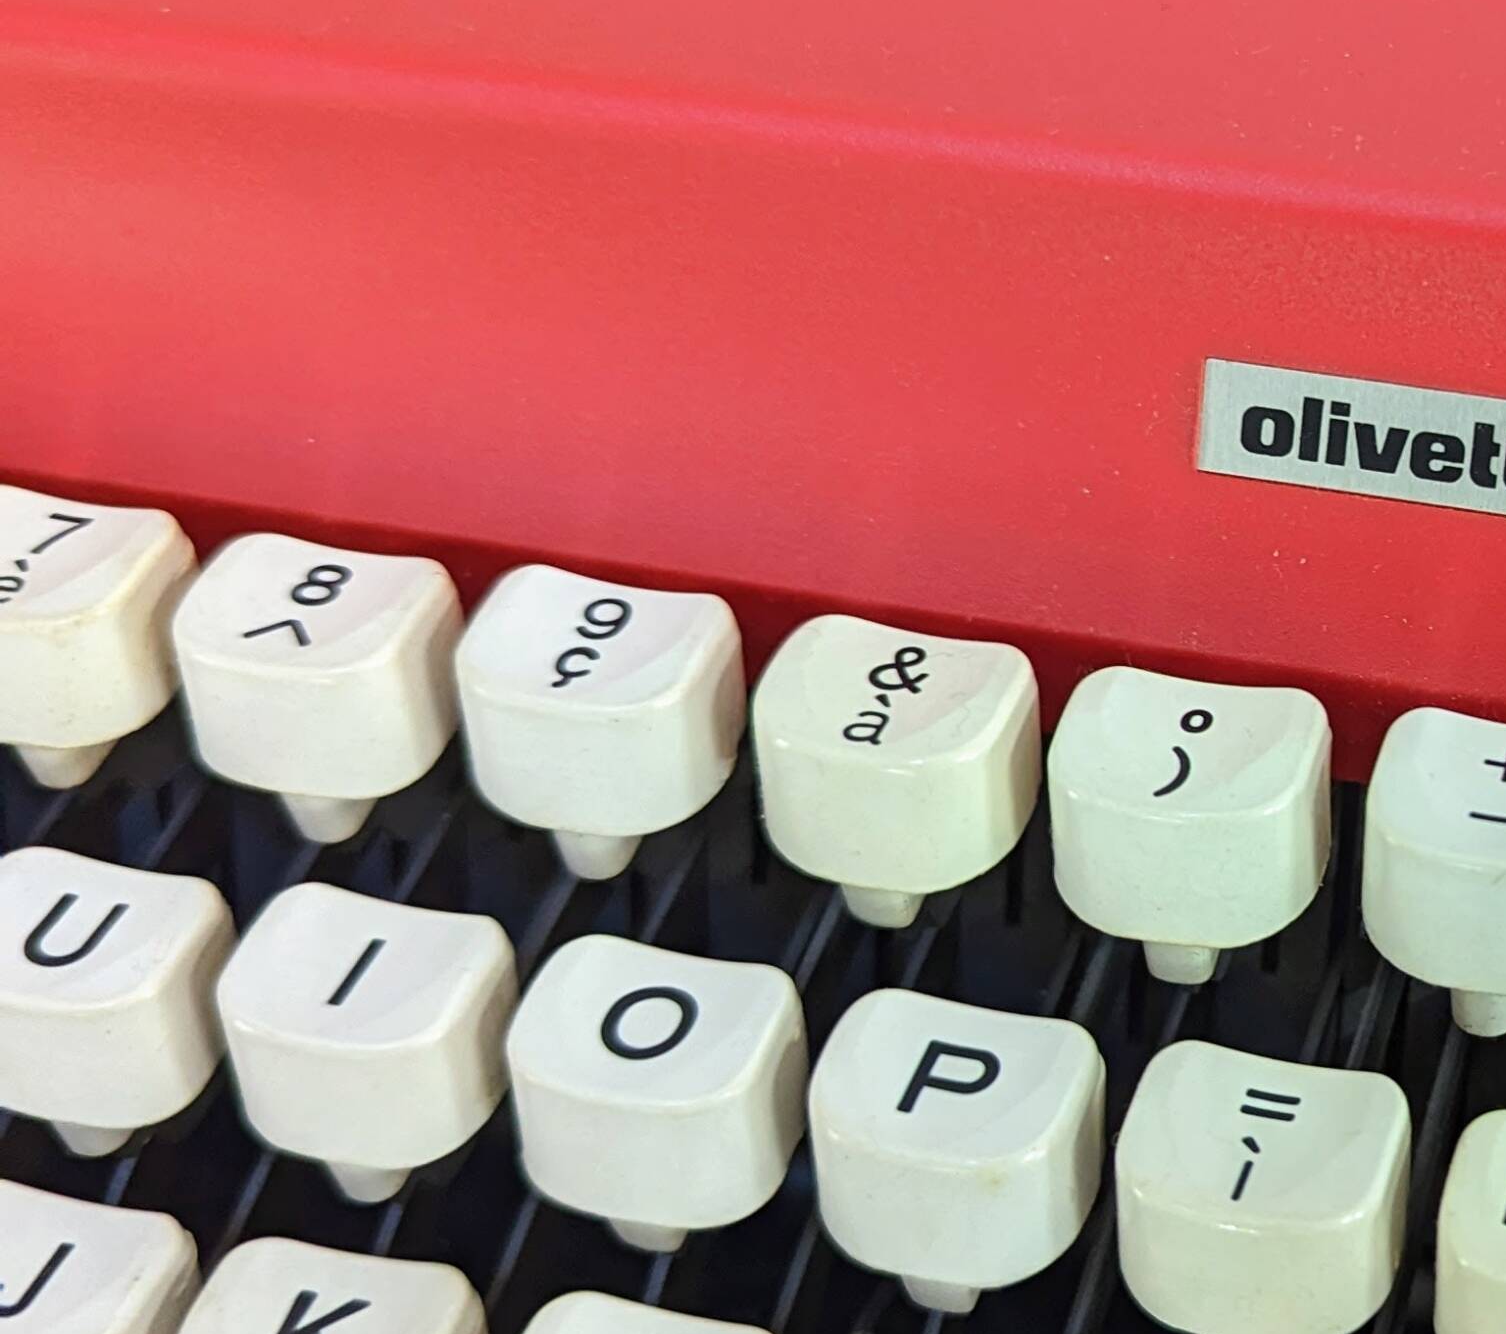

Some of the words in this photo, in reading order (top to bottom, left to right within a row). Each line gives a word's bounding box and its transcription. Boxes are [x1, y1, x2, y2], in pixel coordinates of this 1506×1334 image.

[30, 512, 95, 554] 7
[289, 564, 352, 607] 8
[575, 598, 632, 640] 9
[551, 646, 601, 689] ç
[868, 646, 929, 695] &
[842, 693, 891, 746] à
[23, 893, 129, 968] U
[326, 938, 386, 1006] I
[599, 986, 698, 1061] O
[896, 1040, 1001, 1114] P
[1239, 1088, 1301, 1122] =
[0, 1242, 75, 1318] J
